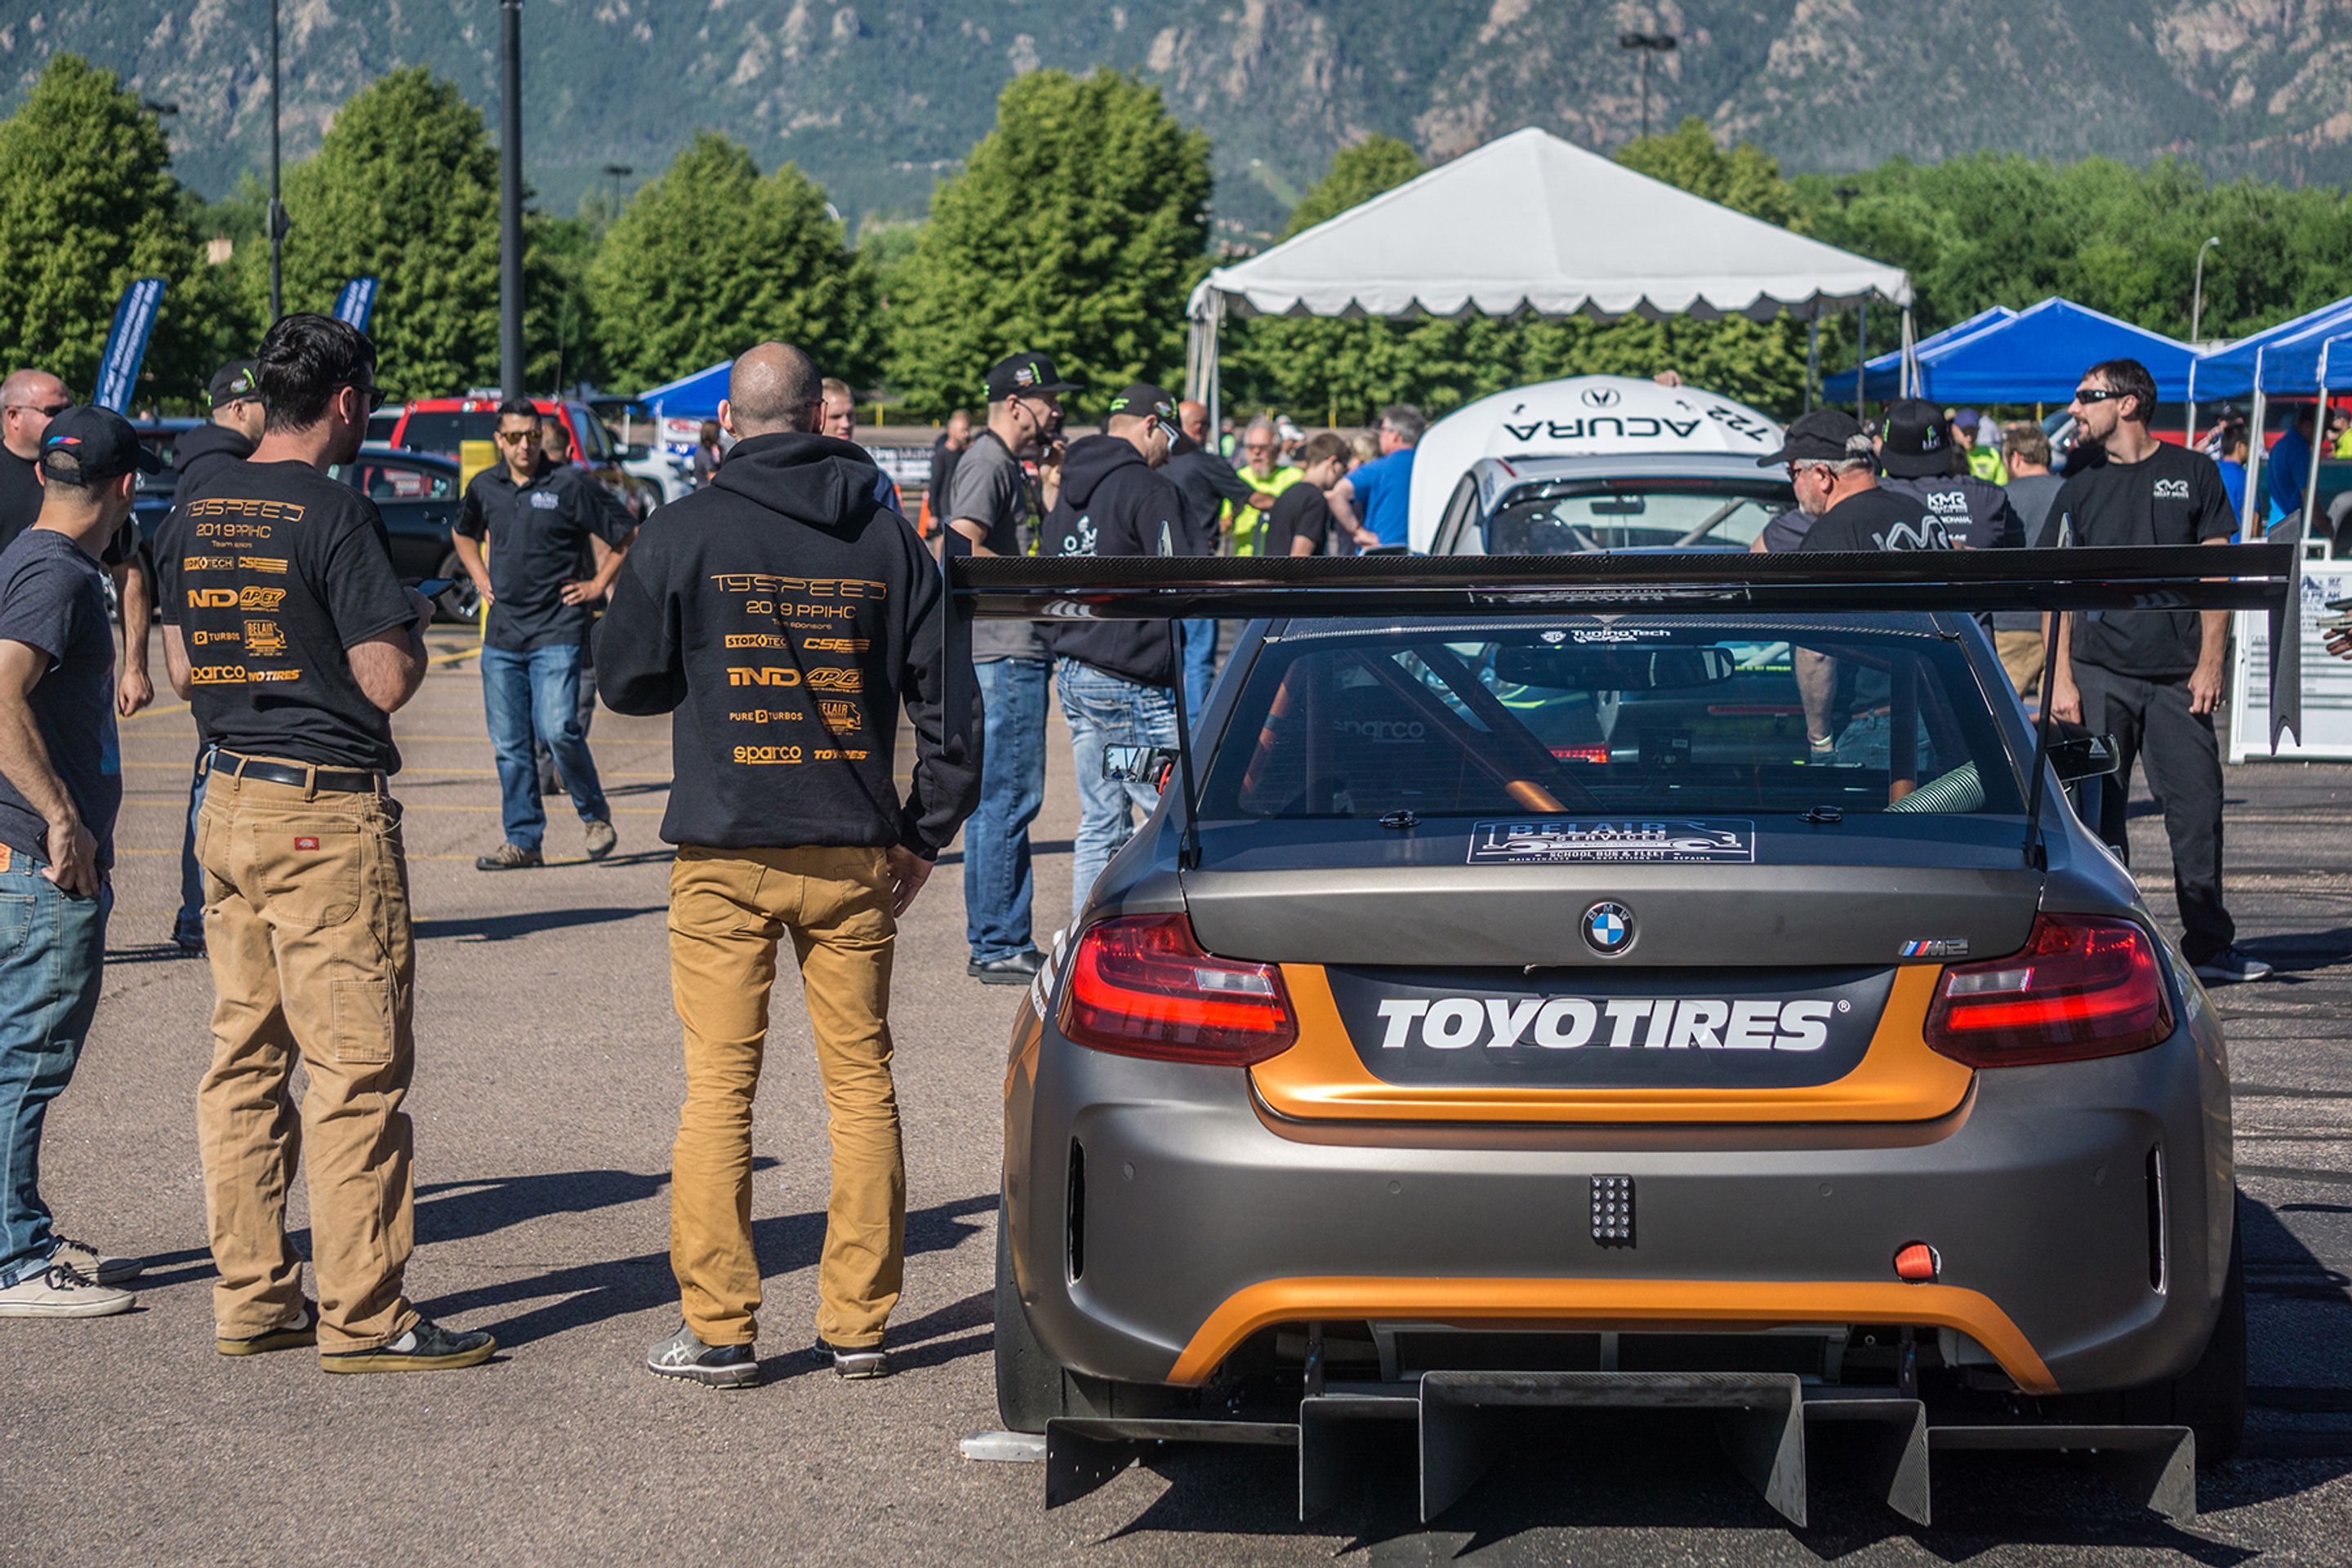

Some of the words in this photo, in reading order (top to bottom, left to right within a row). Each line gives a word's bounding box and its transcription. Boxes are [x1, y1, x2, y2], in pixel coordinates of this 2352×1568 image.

[1503, 416, 1702, 442] ACURA
[196, 523, 235, 537] 2019
[710, 573, 887, 600] TYSPEED
[797, 604, 856, 619] PPIHC
[191, 665, 245, 684] parco
[729, 711, 754, 721] PURE
[768, 711, 804, 721] TURBOS
[733, 745, 803, 764] sparco
[1508, 822, 1667, 835] BELAIR
[1549, 850, 1593, 858] SCHOOL
[1377, 997, 1598, 1050] TOYO
